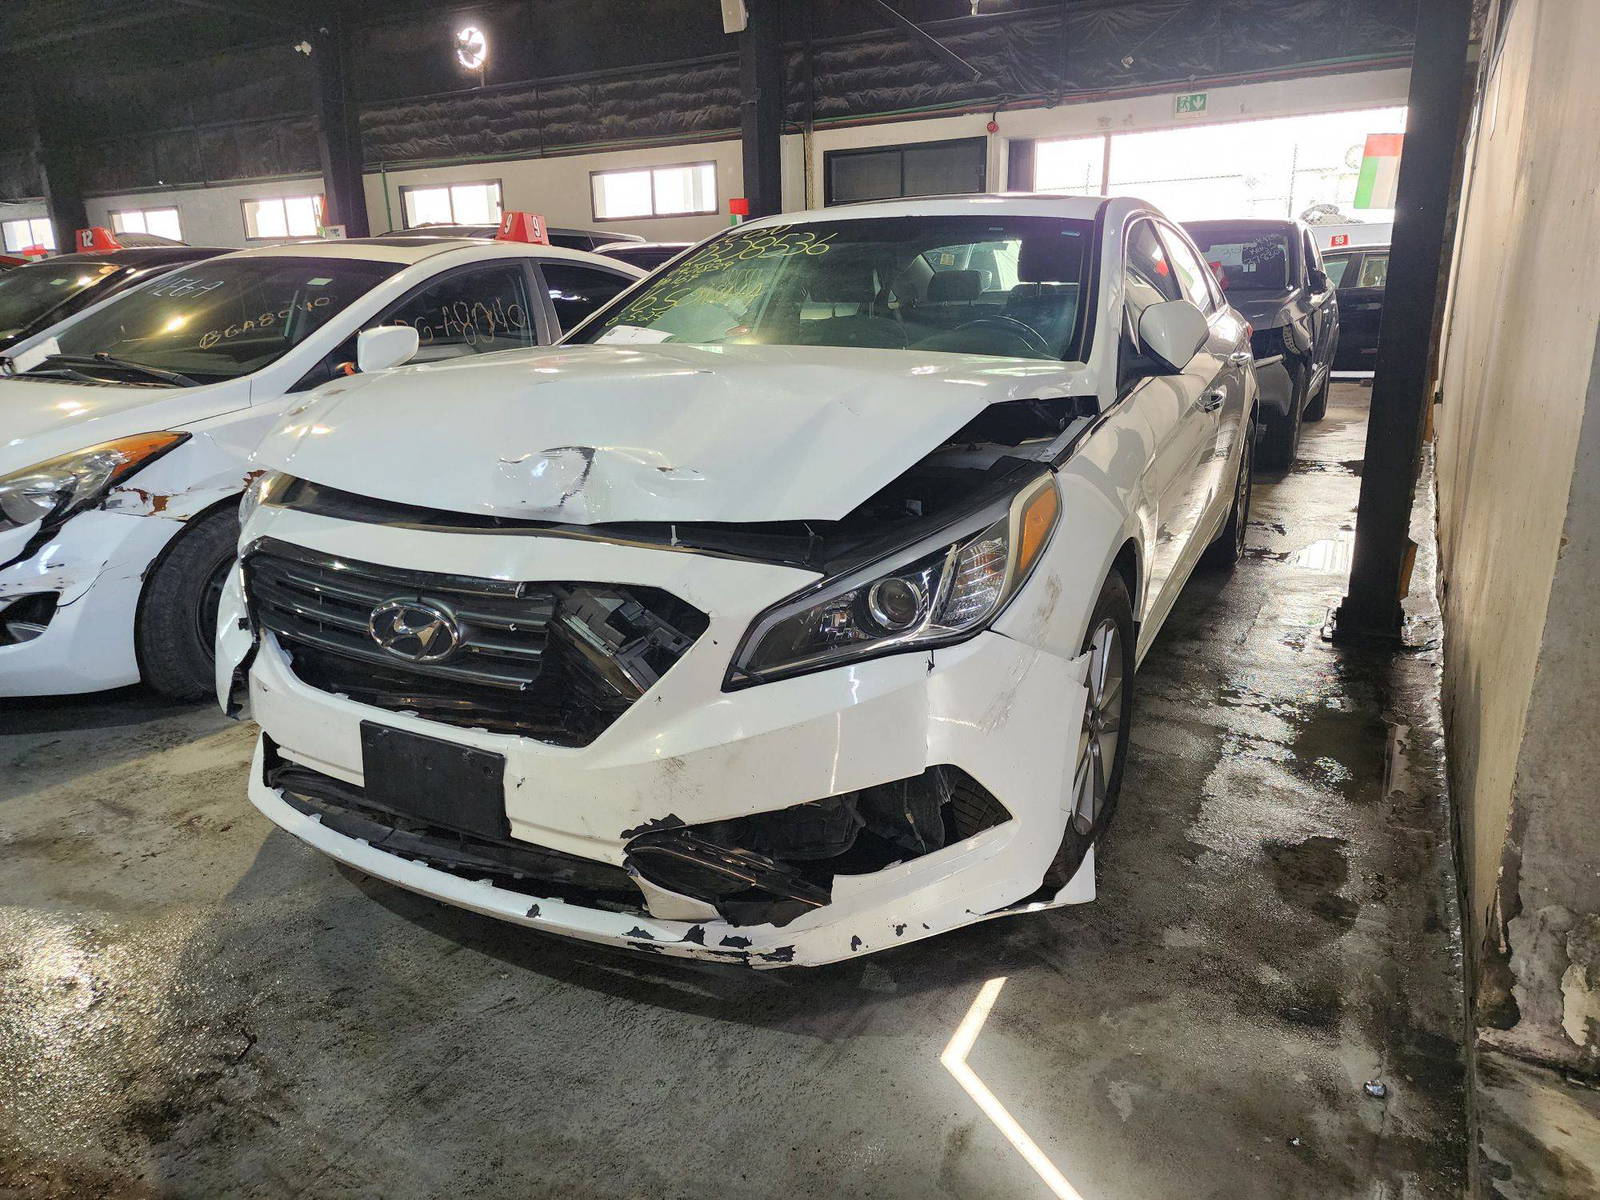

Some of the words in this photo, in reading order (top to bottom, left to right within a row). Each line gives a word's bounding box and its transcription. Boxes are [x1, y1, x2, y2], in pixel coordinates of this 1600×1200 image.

[504, 212, 513, 235] 9
[532, 215, 542, 238] 9
[81, 229, 95, 248] 12
